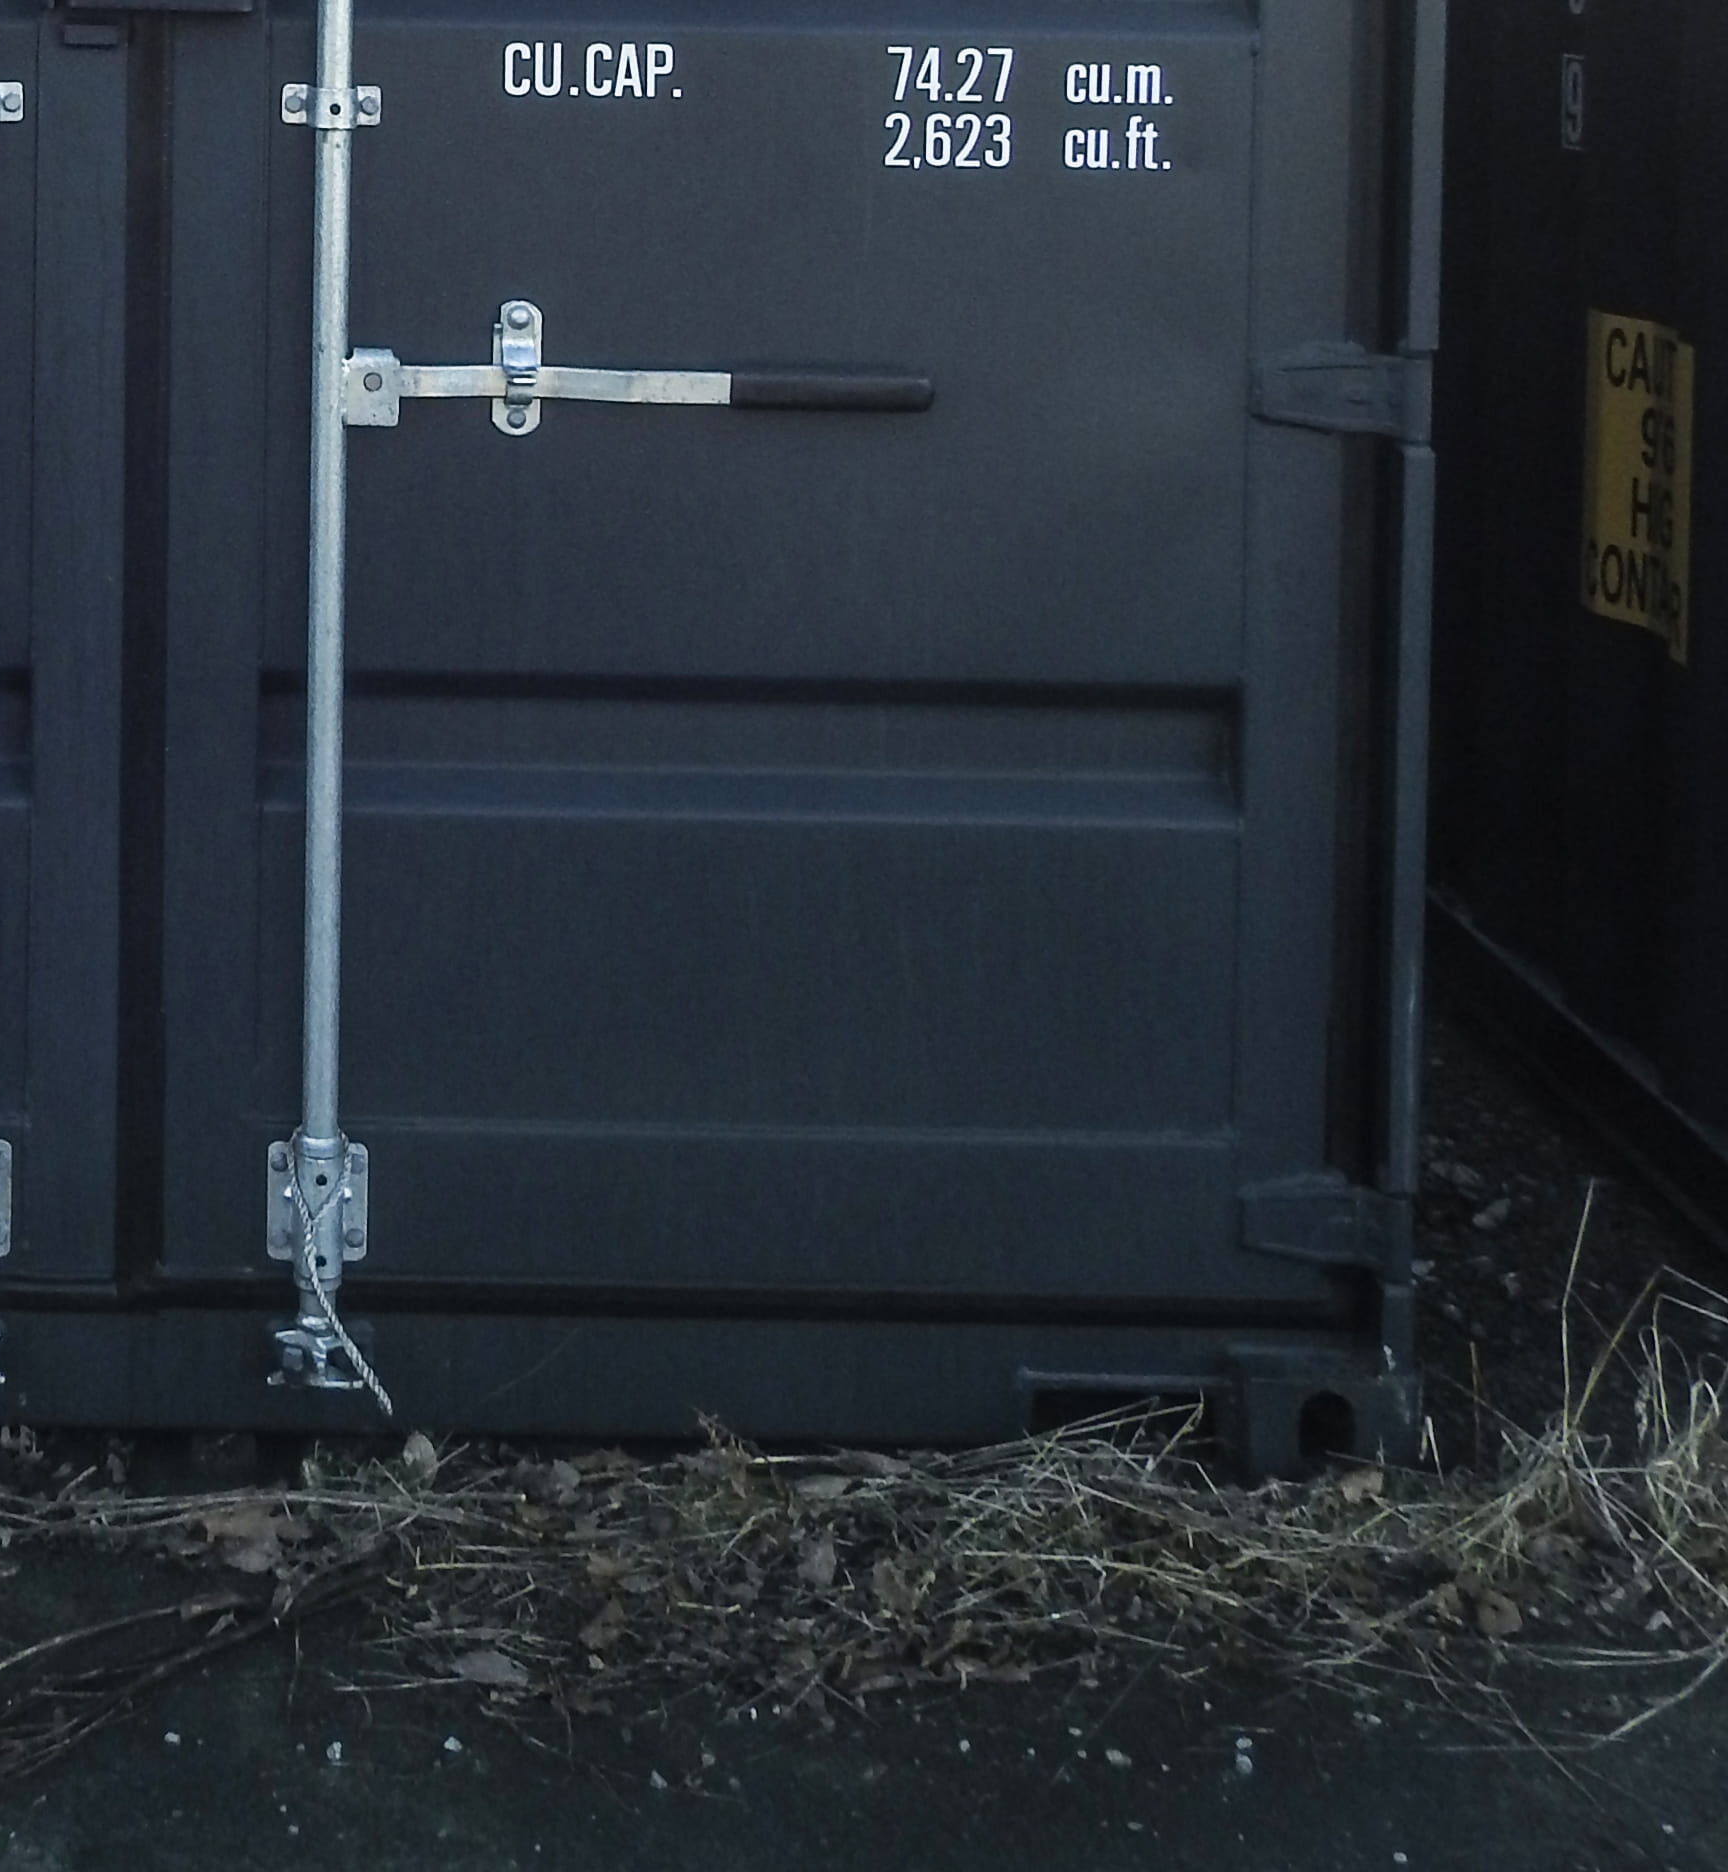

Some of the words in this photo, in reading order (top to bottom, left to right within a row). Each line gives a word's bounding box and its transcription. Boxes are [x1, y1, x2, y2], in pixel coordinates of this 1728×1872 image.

[505, 43, 681, 97] CU.CAP.
[888, 47, 1012, 101] 74.27
[1067, 64, 1172, 104] cu.m.
[885, 113, 1010, 168] 2,623
[1065, 116, 1170, 169] cu.ft.
